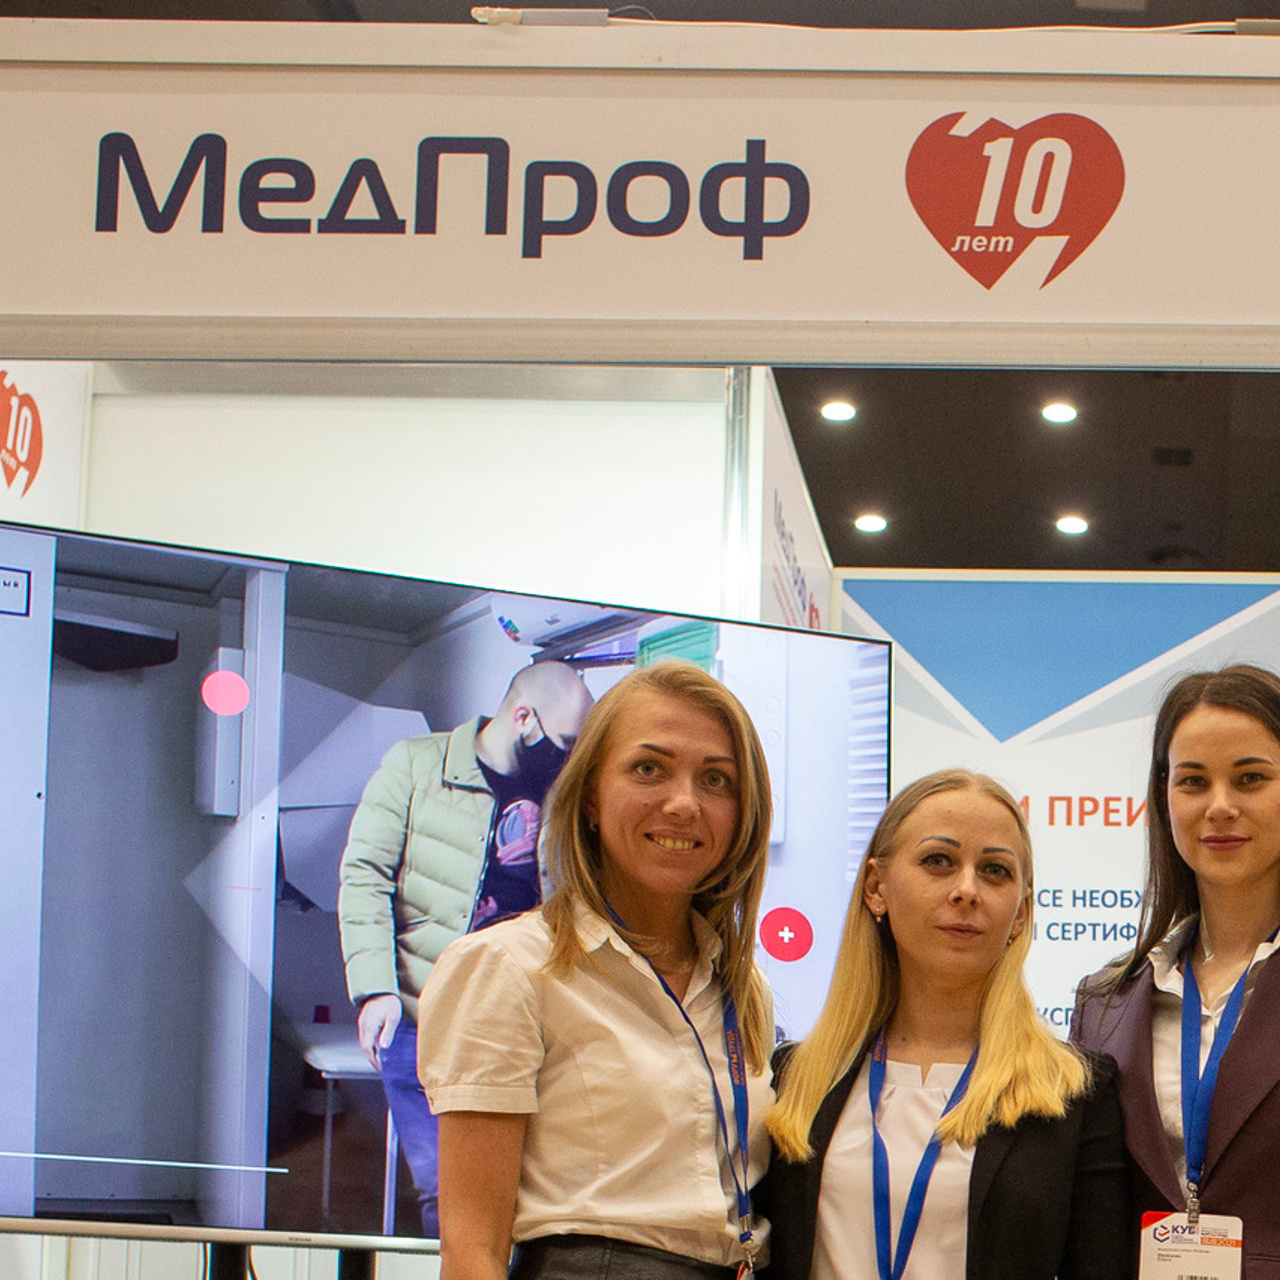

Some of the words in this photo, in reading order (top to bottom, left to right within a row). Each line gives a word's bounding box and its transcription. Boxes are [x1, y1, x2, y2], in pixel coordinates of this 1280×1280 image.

[95, 131, 811, 261] МедПроф
[973, 136, 1073, 230] 10
[951, 235, 1015, 253] лет
[6, 395, 33, 463] 10
